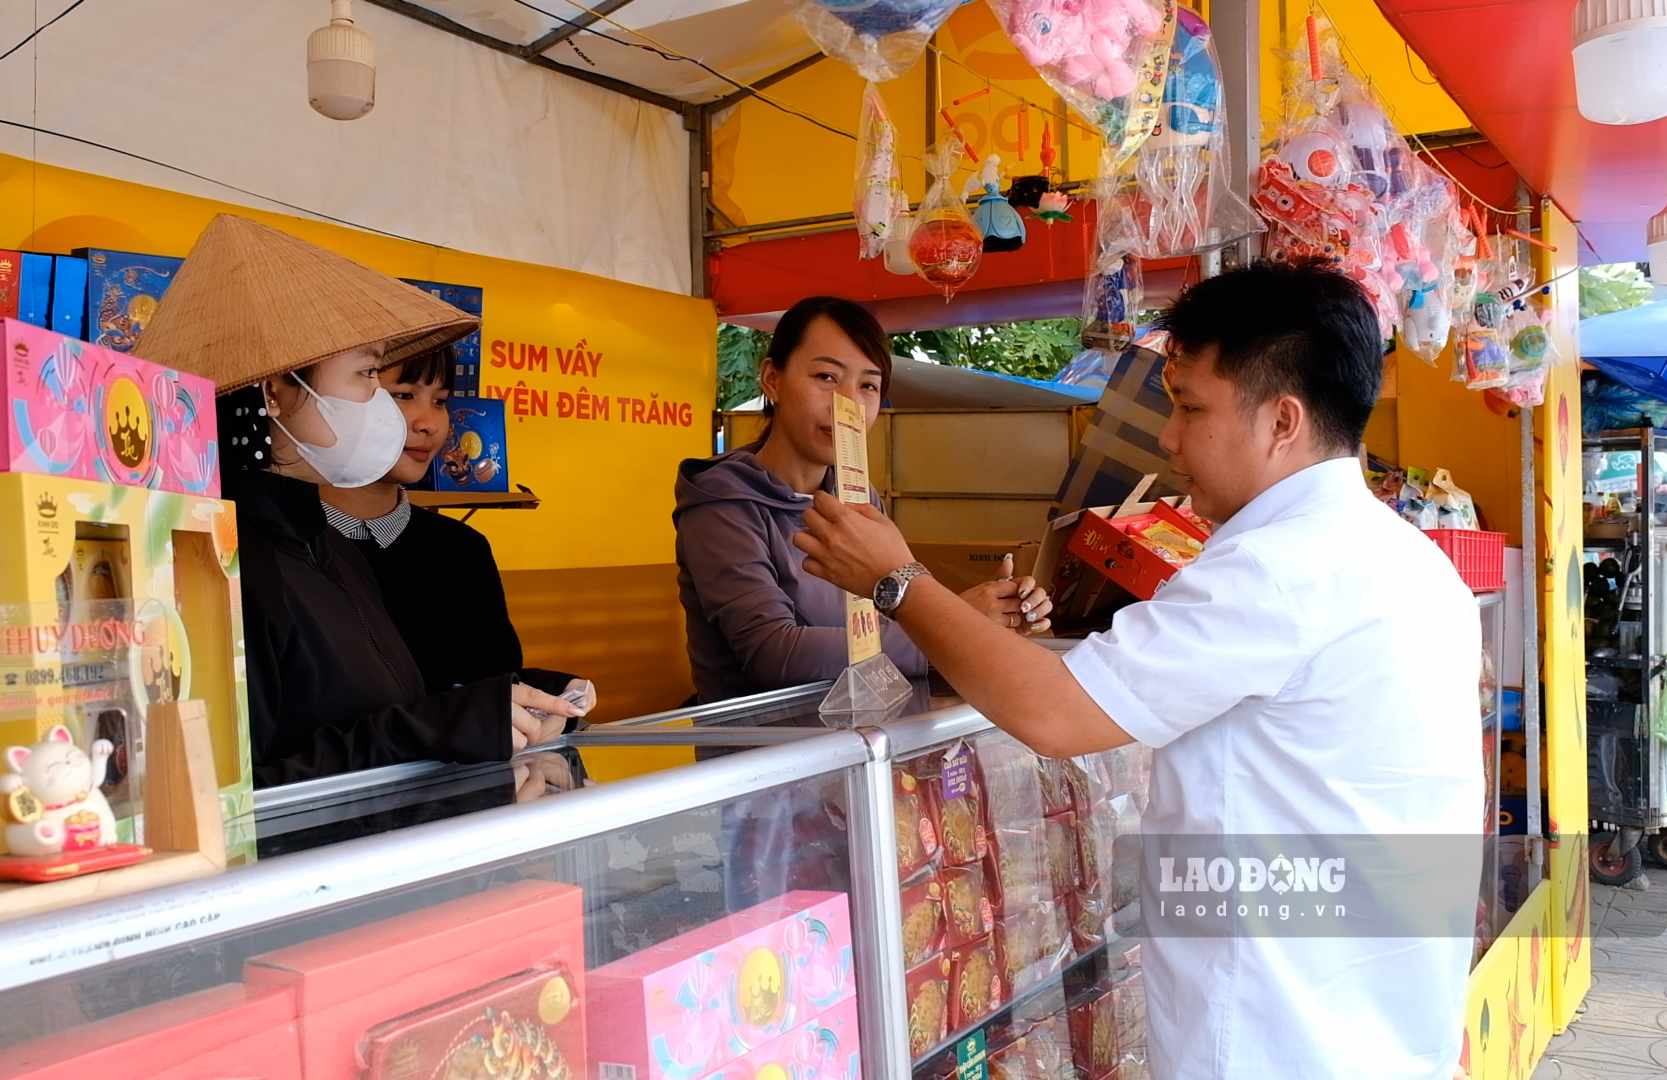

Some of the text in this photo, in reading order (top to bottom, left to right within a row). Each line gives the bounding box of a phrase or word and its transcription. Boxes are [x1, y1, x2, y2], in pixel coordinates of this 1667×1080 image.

[490, 338, 603, 378] SUM VẦY
[556, 386, 610, 421] ĐÊM
[617, 393, 693, 427] TRĂNG
